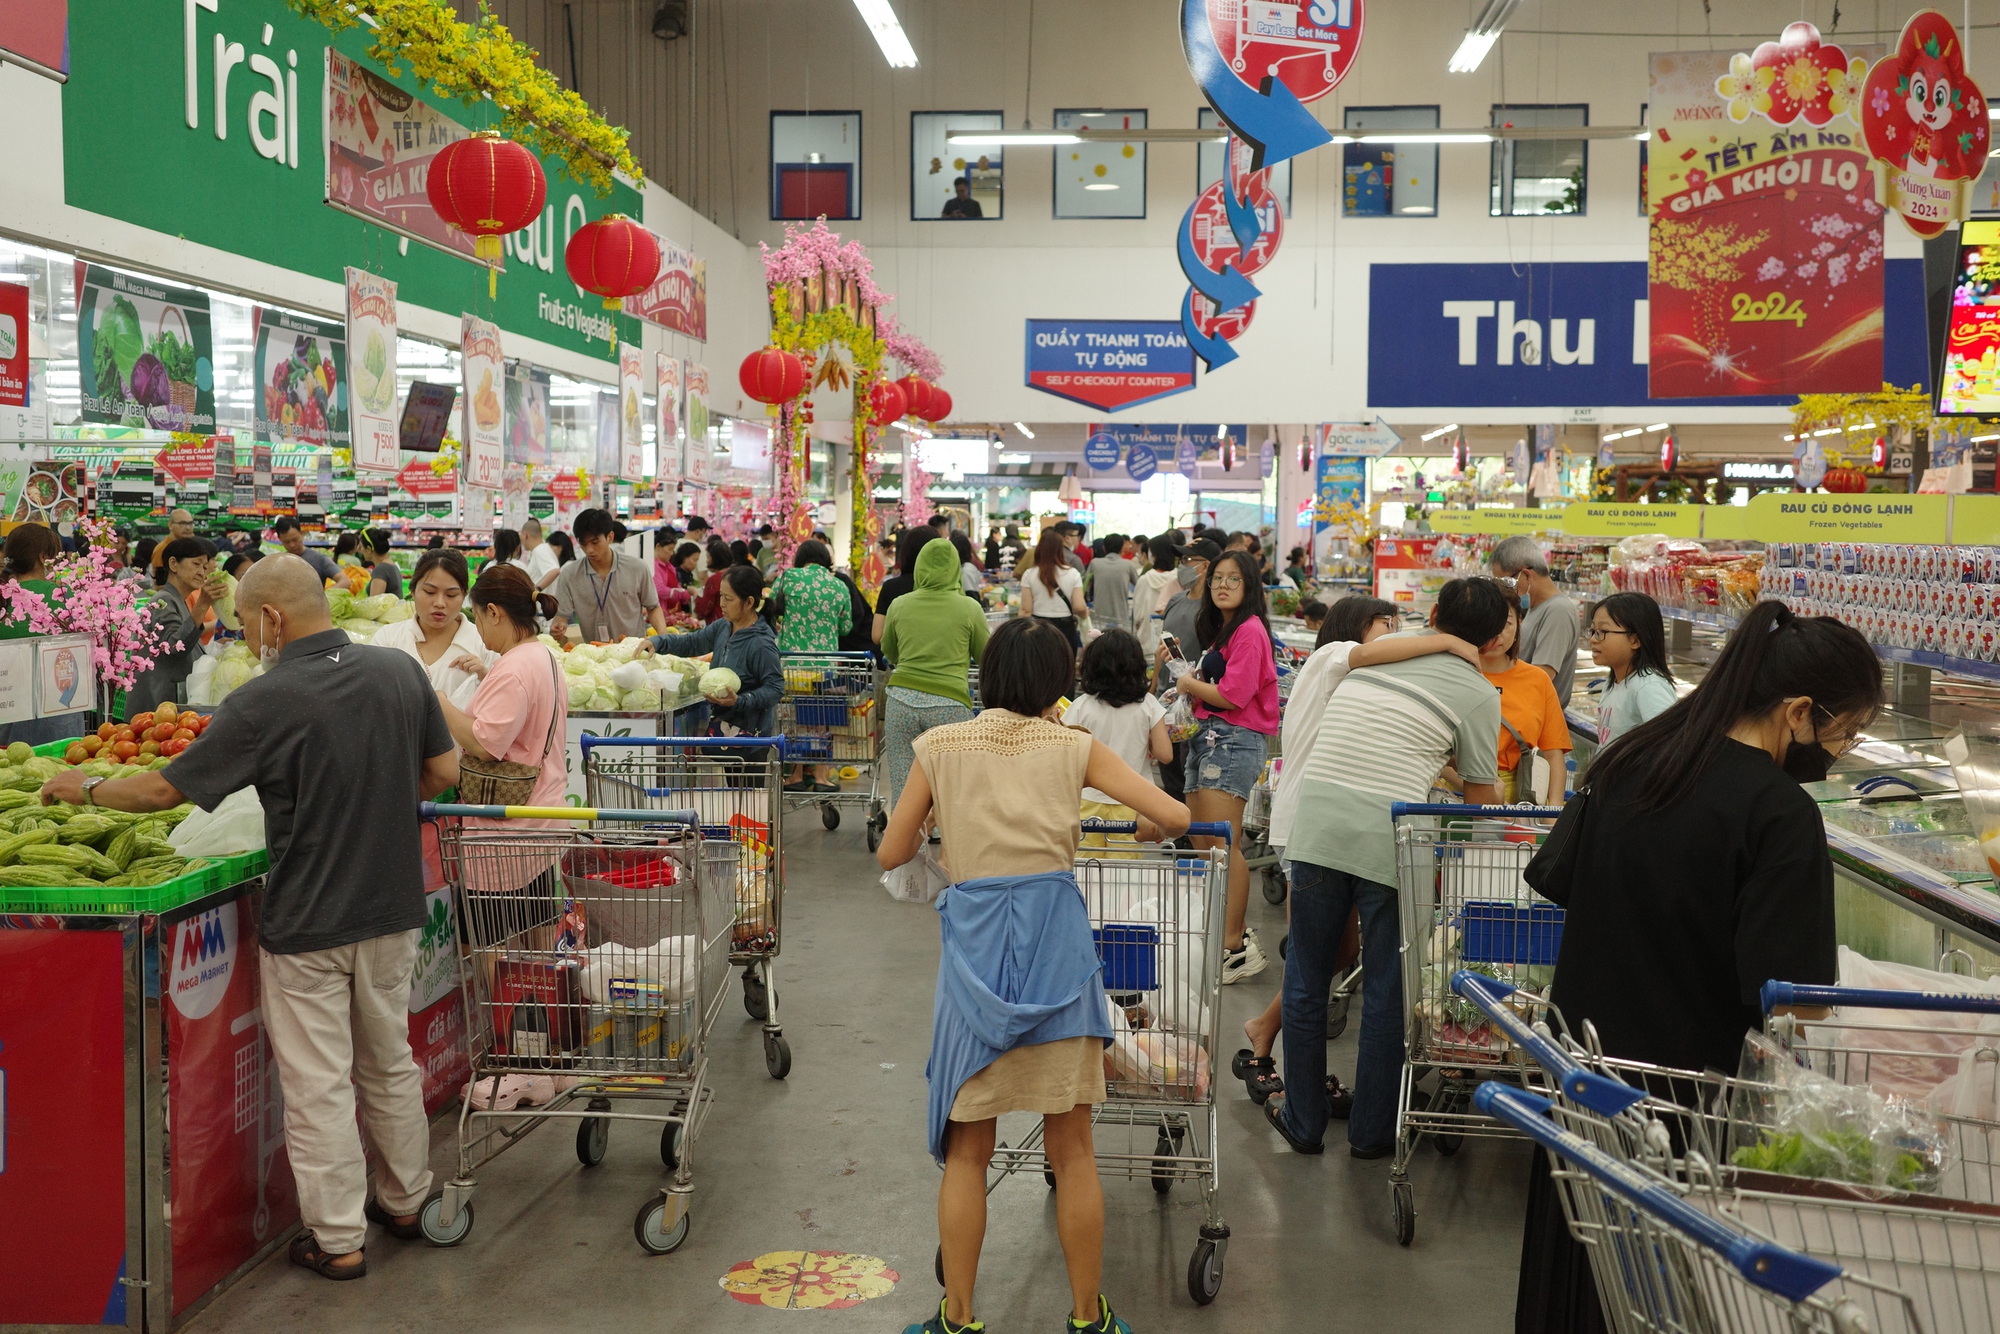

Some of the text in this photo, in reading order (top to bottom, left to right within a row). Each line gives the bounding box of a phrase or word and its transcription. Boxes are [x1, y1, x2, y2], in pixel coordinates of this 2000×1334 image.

[1257, 22, 1338, 41] Pay Less Get More
[1705, 137, 1757, 174] TẾT
[373, 167, 405, 202] GIÁ
[1669, 154, 1859, 213] GIÁ KHỎI LO
[1928, 183, 1952, 201] Xuân
[1911, 201, 1939, 217] 2024
[539, 292, 566, 328] Fruits
[566, 304, 575, 330] &
[1730, 292, 1807, 327] 2024
[1085, 333, 1140, 347] THANH
[1144, 331, 1188, 348] TOÁN
[1443, 300, 1595, 365] Thu
[1074, 350, 1148, 369] TỰ ĐỘNG
[1046, 376, 1176, 386] SELF CHECKOUT COUNTER
[83, 392, 99, 412] Rau
[112, 397, 124, 416] An
[380, 433, 394, 450] 500
[1724, 463, 1794, 478] HIMALA
[1892, 458, 1912, 469] 20
[1587, 507, 1677, 519] RAU CỦ ĐÔNG LẠNH
[1780, 501, 1914, 517] RAU CỦ ĐÔNG LẠNH
[1809, 519, 1883, 529] Frozen Vegetables
[176, 974, 199, 995] Mega
[427, 1012, 445, 1046] Giá
